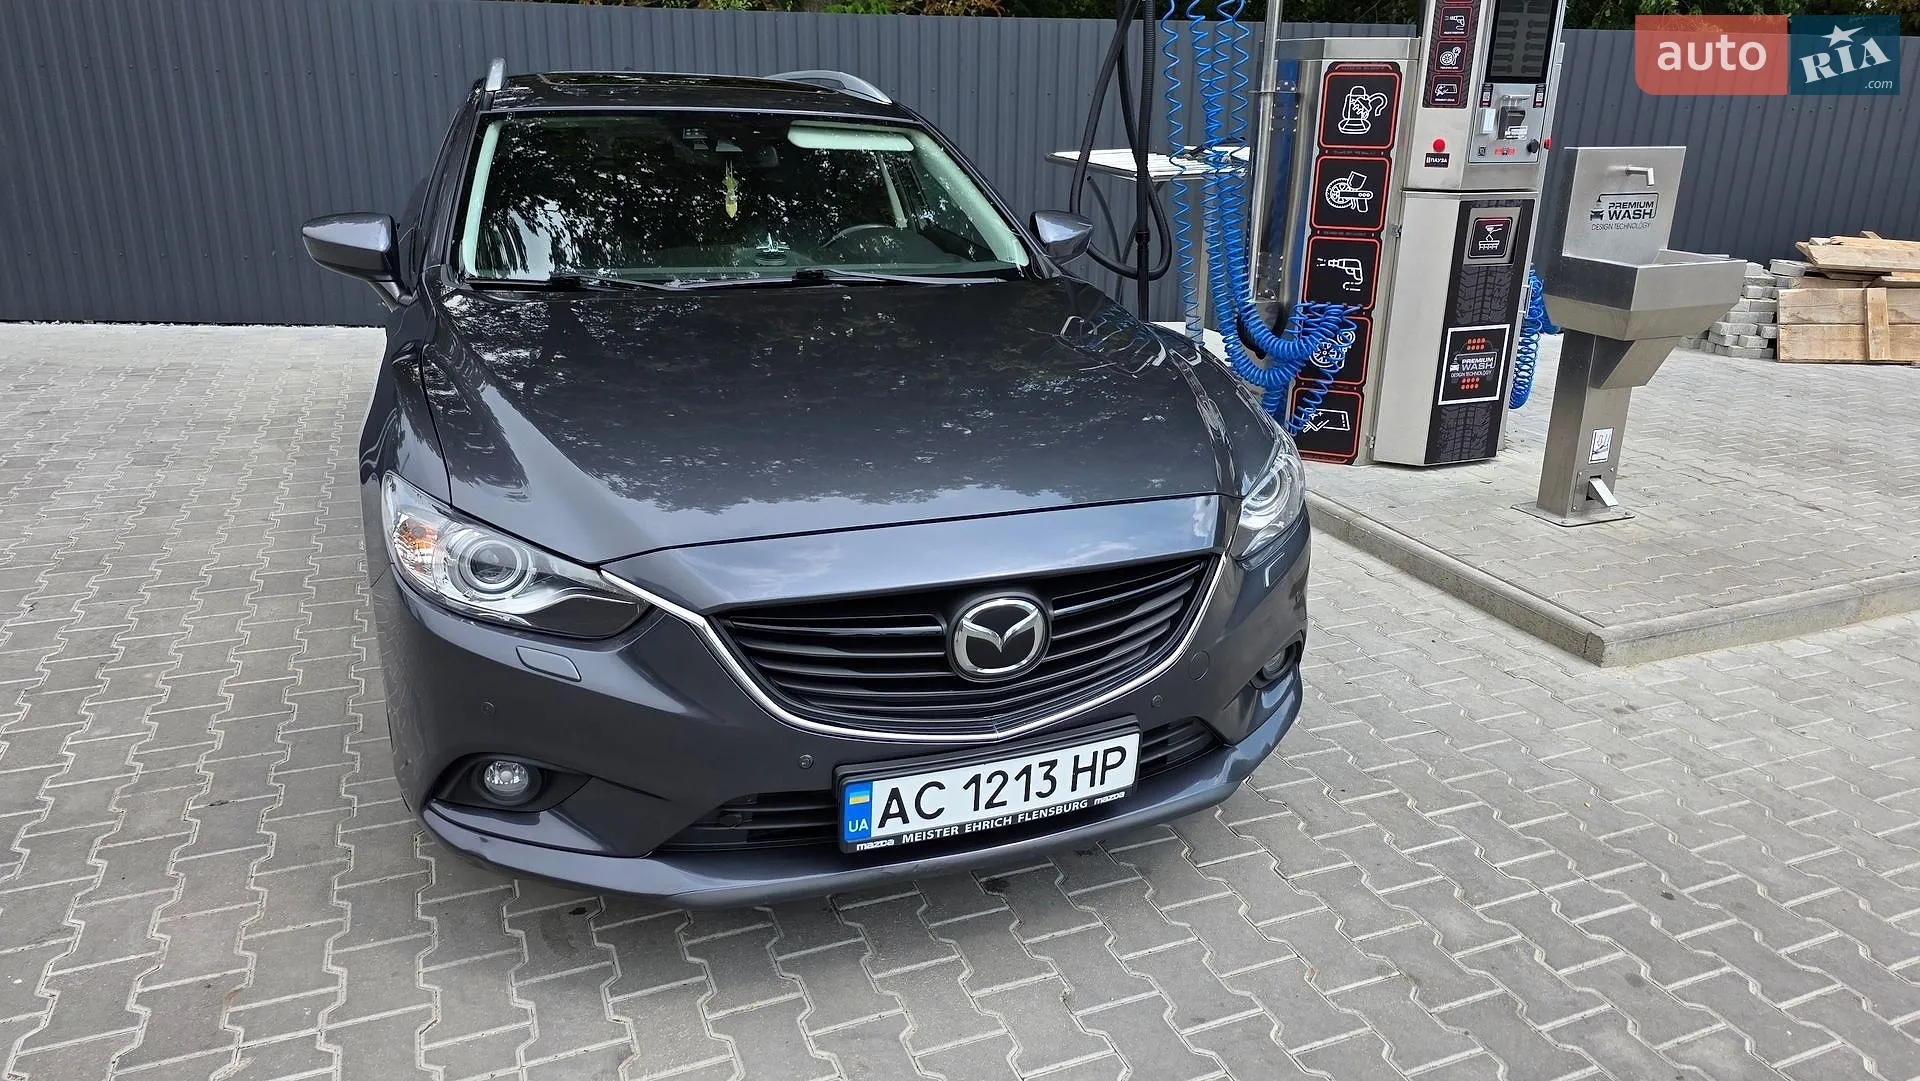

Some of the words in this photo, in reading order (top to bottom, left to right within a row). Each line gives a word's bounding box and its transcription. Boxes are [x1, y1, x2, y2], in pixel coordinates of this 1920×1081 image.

[1608, 201, 1654, 209] PREMIUM
[1608, 209, 1653, 220] WASH
[1591, 223, 1613, 231] DESIGN
[1461, 363, 1493, 371] WASH
[877, 781, 946, 829] AC
[962, 758, 1058, 812] 1213
[1071, 745, 1127, 793] HP
[848, 819, 869, 833] UA
[856, 838, 895, 852] mazda
[902, 825, 960, 844] MEISTER
[964, 816, 1012, 833] EHRICH
[1017, 799, 1088, 823] FLENSBURG
[1093, 791, 1125, 805] mazda
